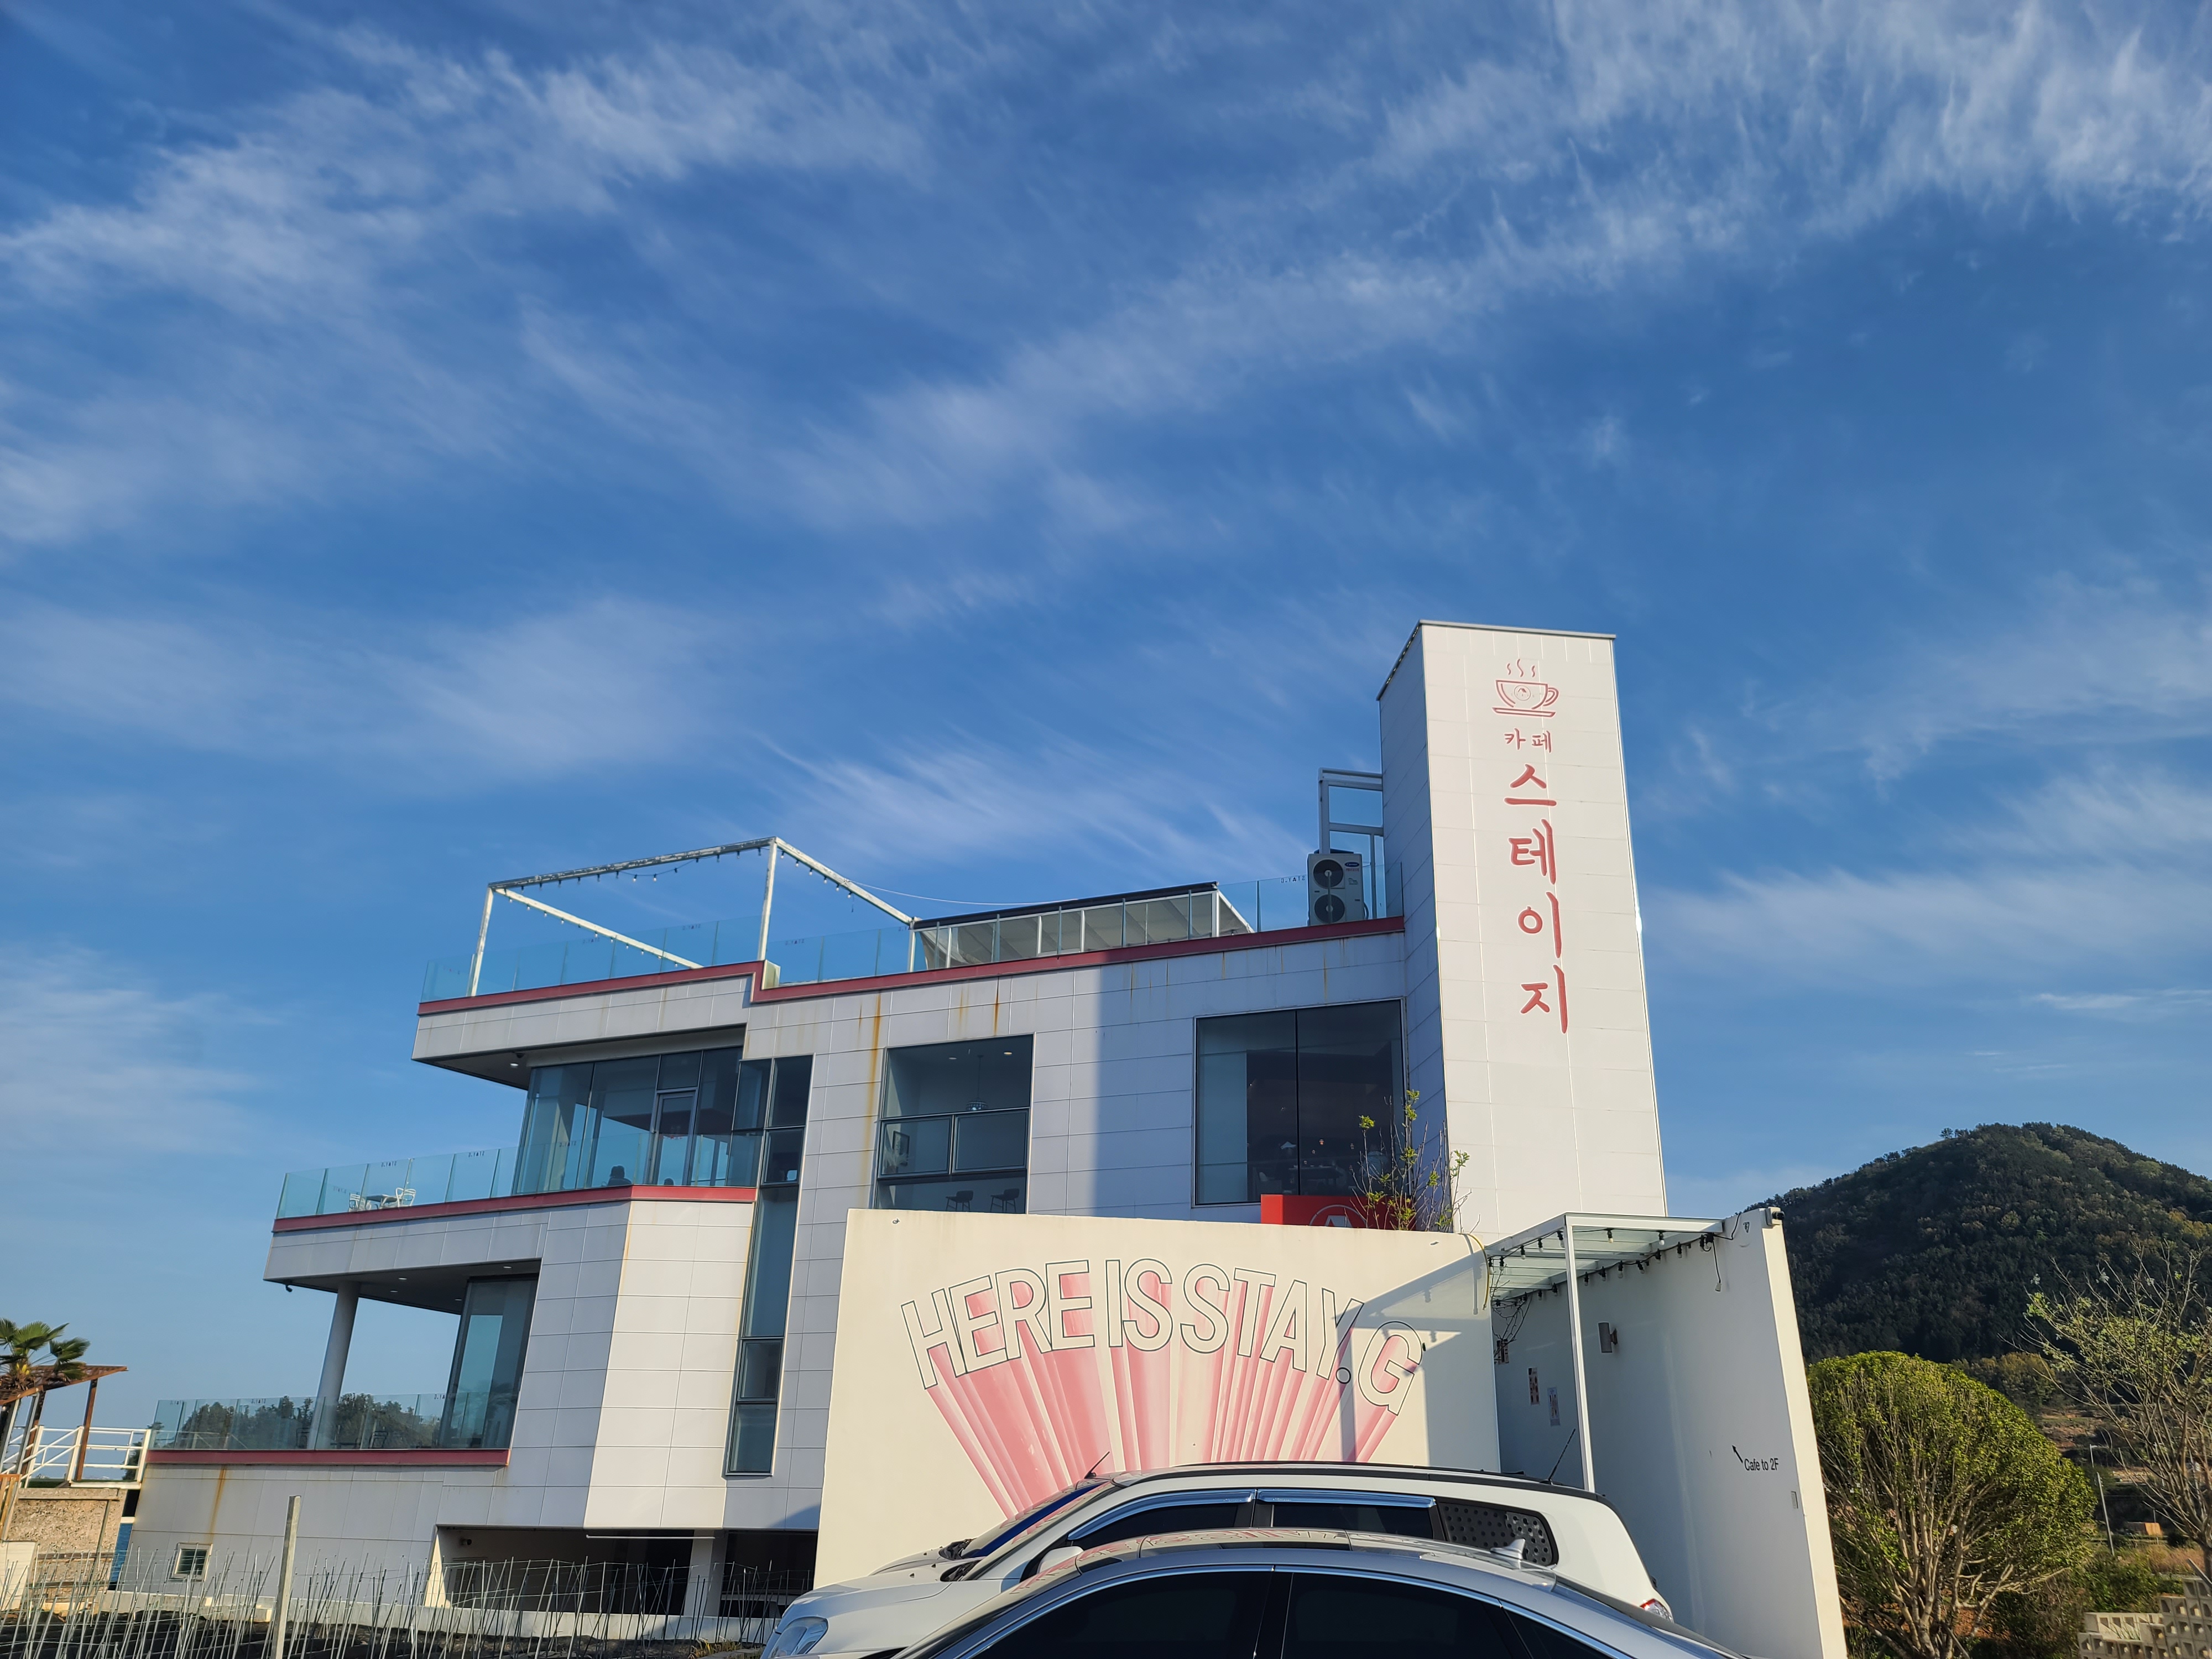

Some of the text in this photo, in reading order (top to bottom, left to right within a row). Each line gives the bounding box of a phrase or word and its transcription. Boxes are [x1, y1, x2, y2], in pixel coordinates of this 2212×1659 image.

[1504, 728, 1552, 753] 카페
[1504, 764, 1568, 1034] 스테이지
[901, 1260, 1095, 1390] HERE
[1106, 1258, 1173, 1352] IS
[1744, 1458, 1779, 1471] Cafe to 2F
